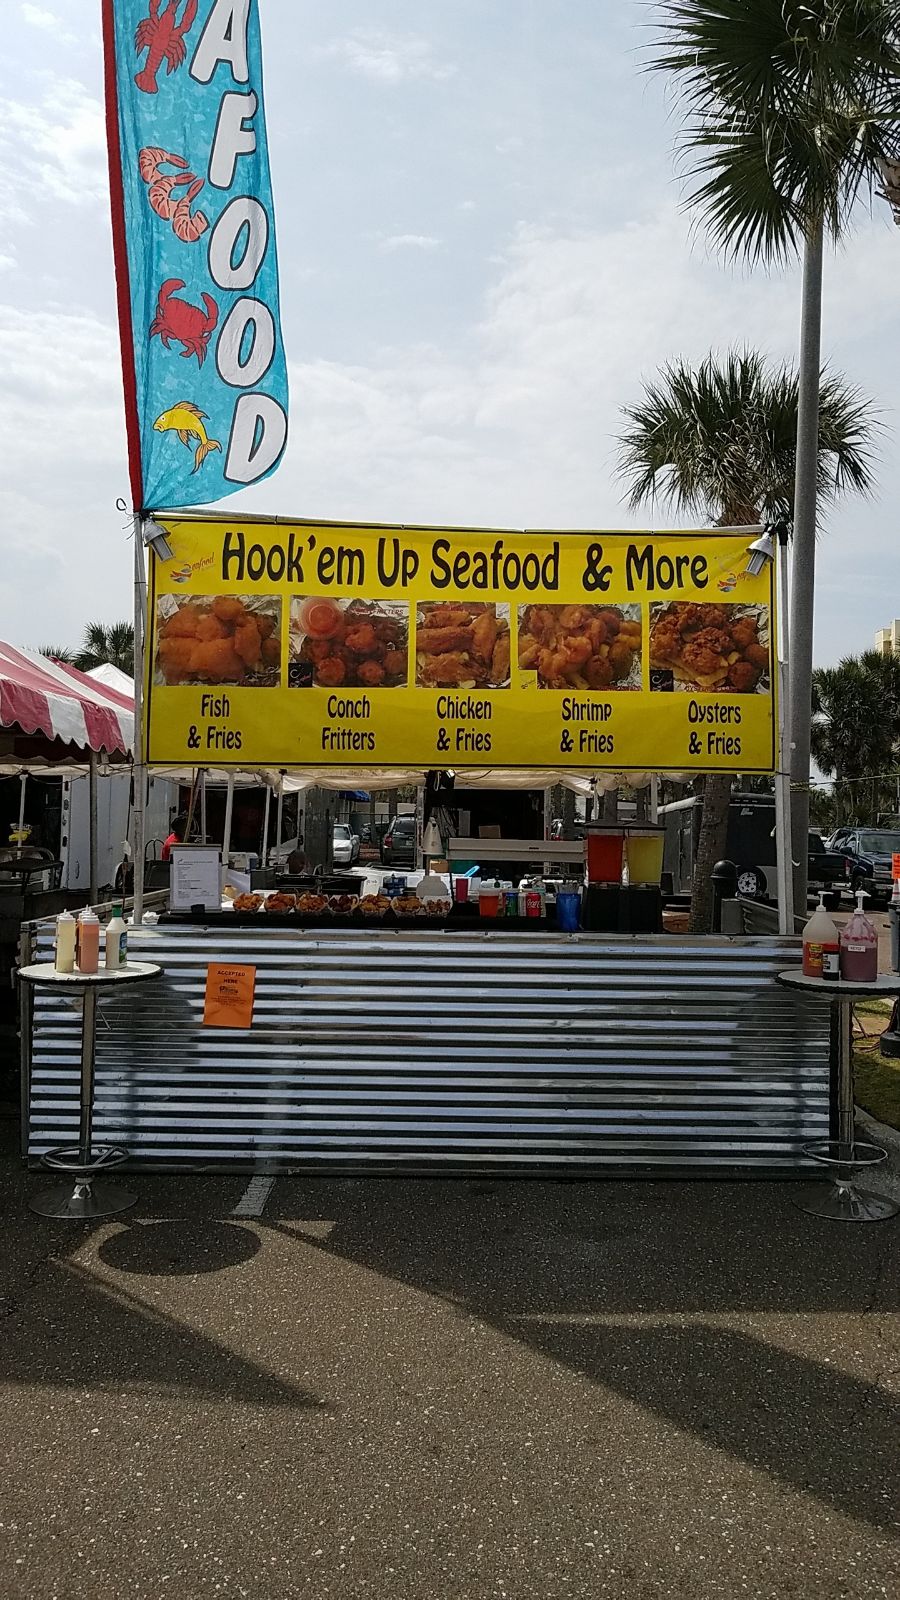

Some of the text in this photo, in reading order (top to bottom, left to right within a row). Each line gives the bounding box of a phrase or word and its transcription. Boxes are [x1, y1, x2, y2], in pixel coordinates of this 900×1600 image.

[222, 532, 709, 592] Hook'em Up Seafood & More
[200, 693, 230, 718] Fish
[326, 694, 371, 719] Conch
[436, 695, 492, 720] Chicken
[561, 697, 612, 722] Shrimp
[687, 699, 742, 725] Oysters
[187, 725, 242, 750] & Fries
[321, 726, 376, 751] Fritters
[436, 727, 492, 752] & Fries
[559, 728, 614, 754] & Fries
[688, 731, 742, 756] & Fries
